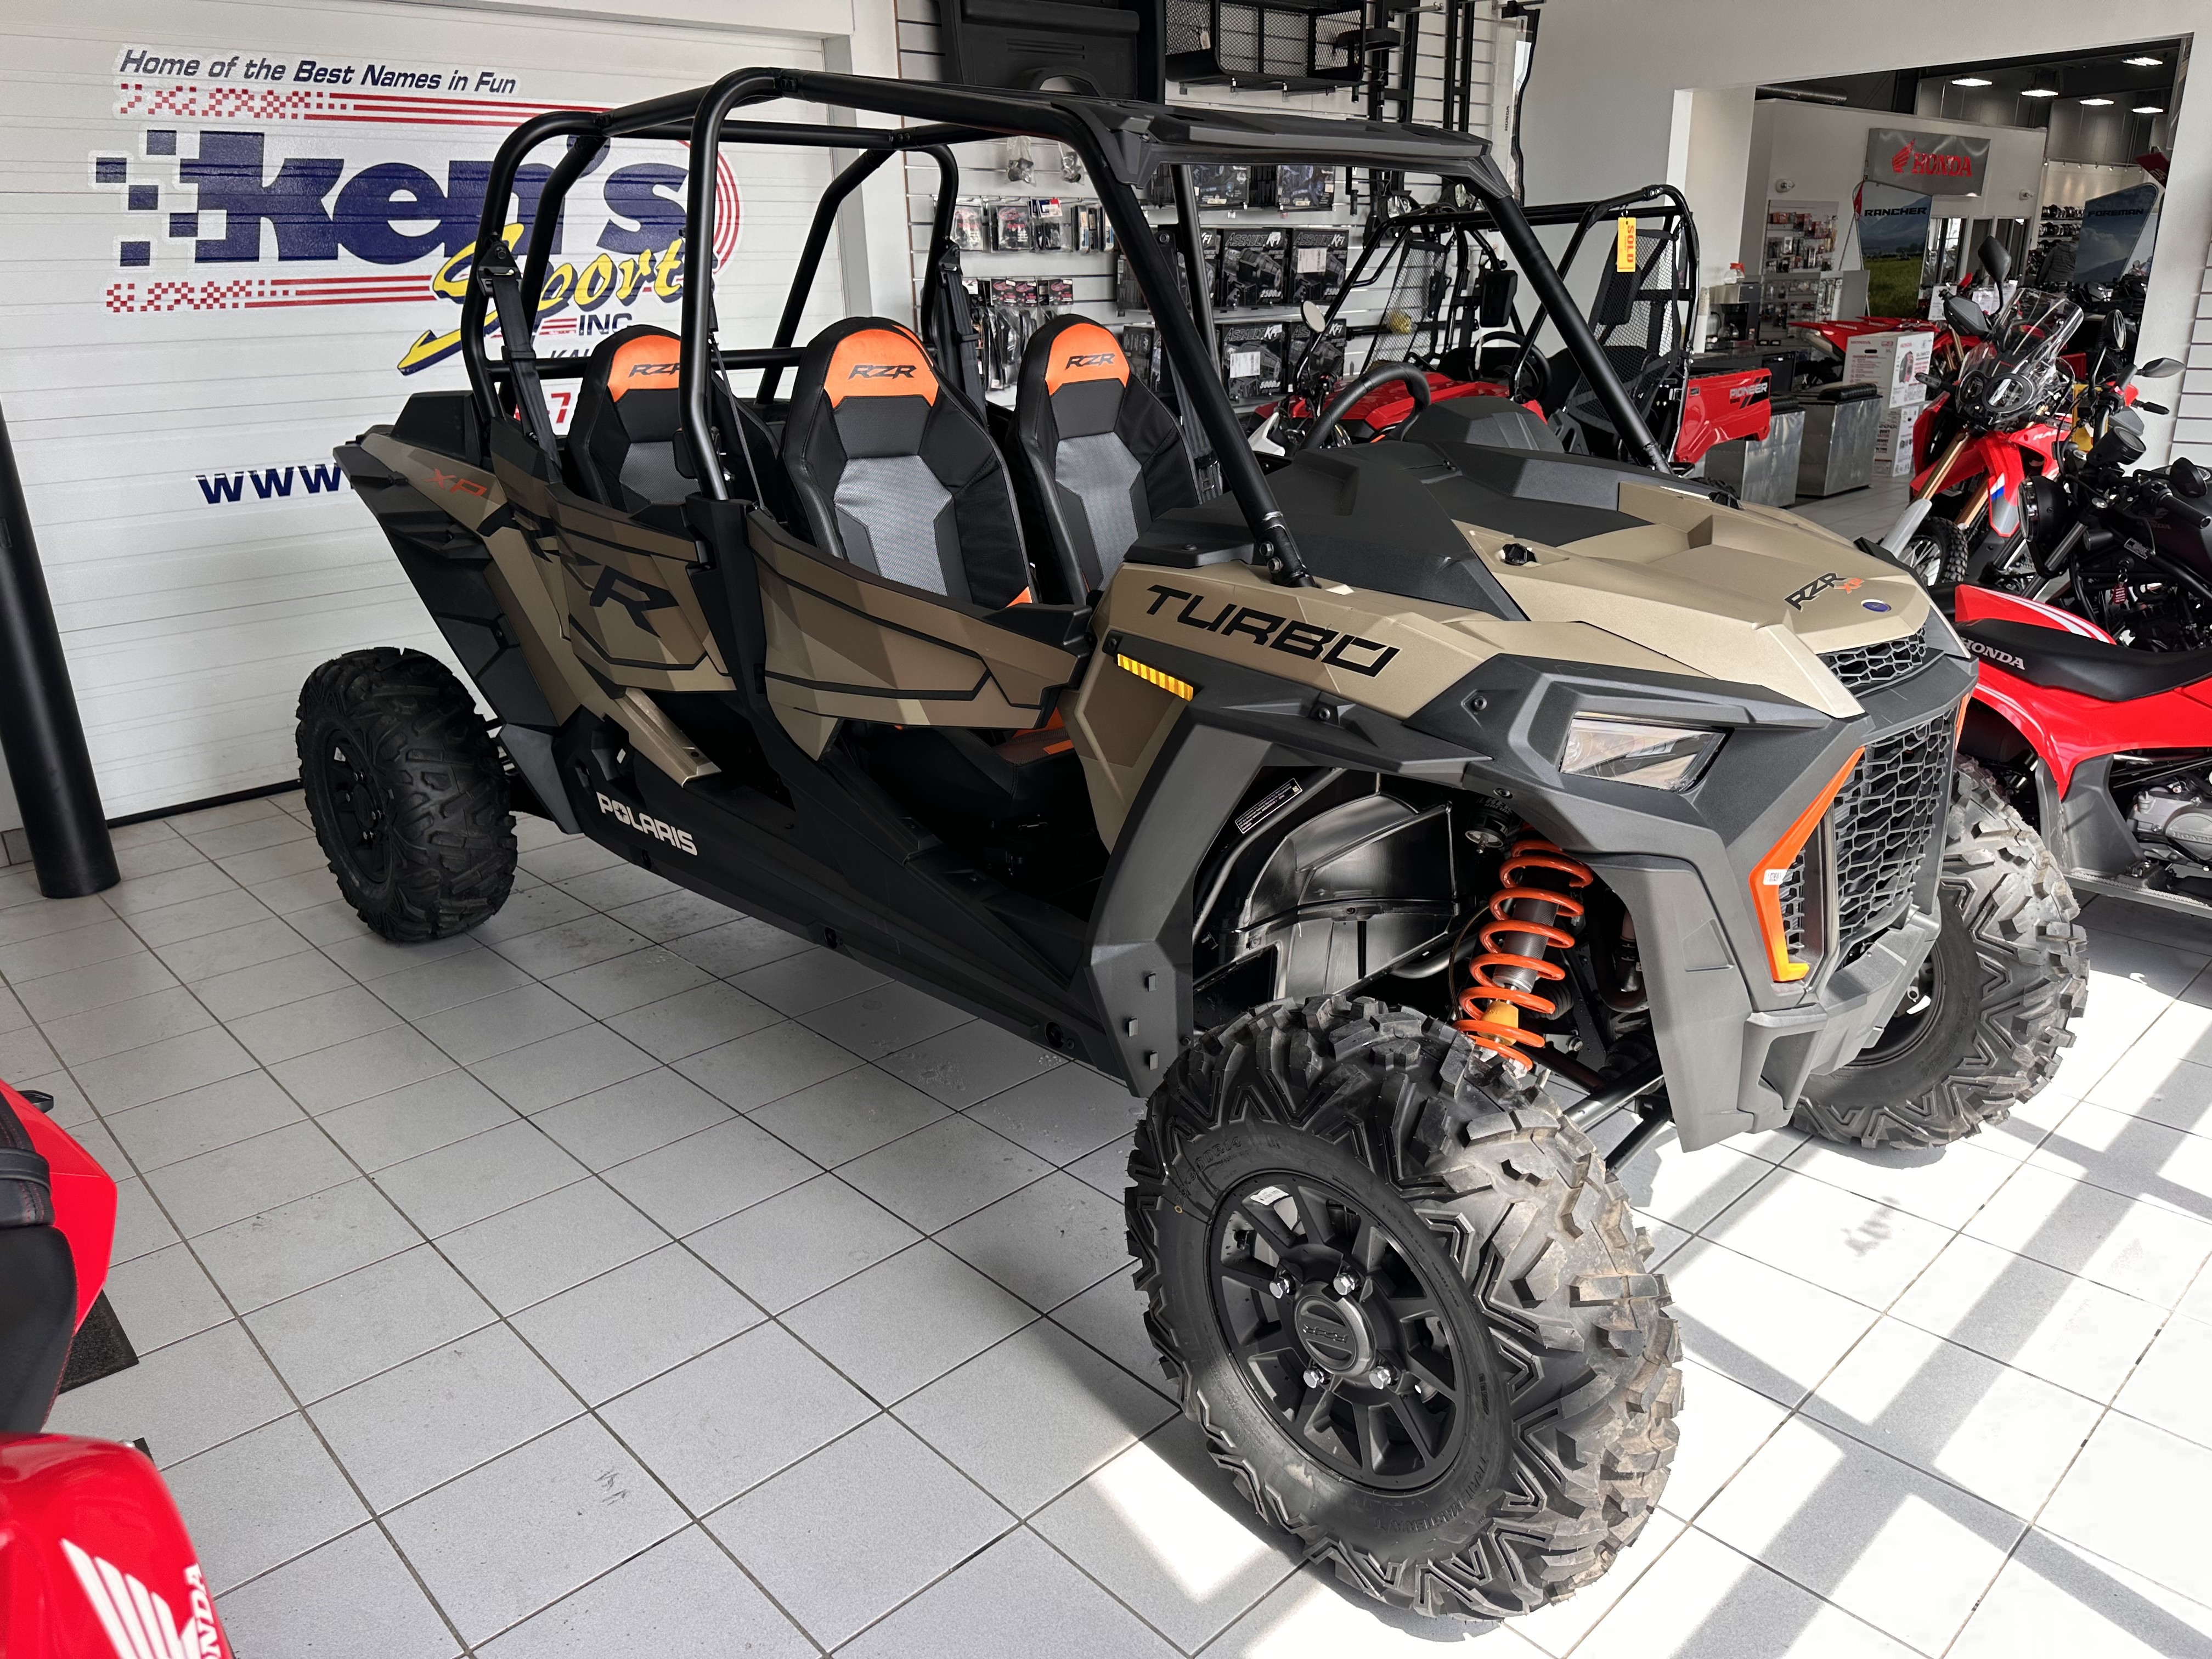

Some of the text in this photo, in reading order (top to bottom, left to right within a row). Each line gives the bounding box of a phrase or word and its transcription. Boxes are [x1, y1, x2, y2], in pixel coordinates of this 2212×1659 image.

[120, 49, 516, 94] Home of the Best Names in Fun
[1911, 153, 1972, 177] HONDA
[1865, 207, 1927, 217] RANCHER
[2088, 208, 2144, 218] FOREMAN
[1224, 232, 1266, 247] ASSAULT
[1293, 232, 1331, 247] ASSAULT
[1223, 328, 1264, 342] ASSAULT
[1065, 353, 1115, 371] RZR
[848, 365, 917, 380] RZR
[1730, 382, 1768, 399] PIONEER
[423, 467, 488, 496] XP
[1785, 573, 1847, 611] RZR
[1147, 584, 1403, 679] TURBO
[1960, 636, 2025, 670] HONDA
[596, 791, 698, 856] POLARIS
[2172, 831, 2212, 843] HOND
[184, 1562, 222, 1659] NDA
